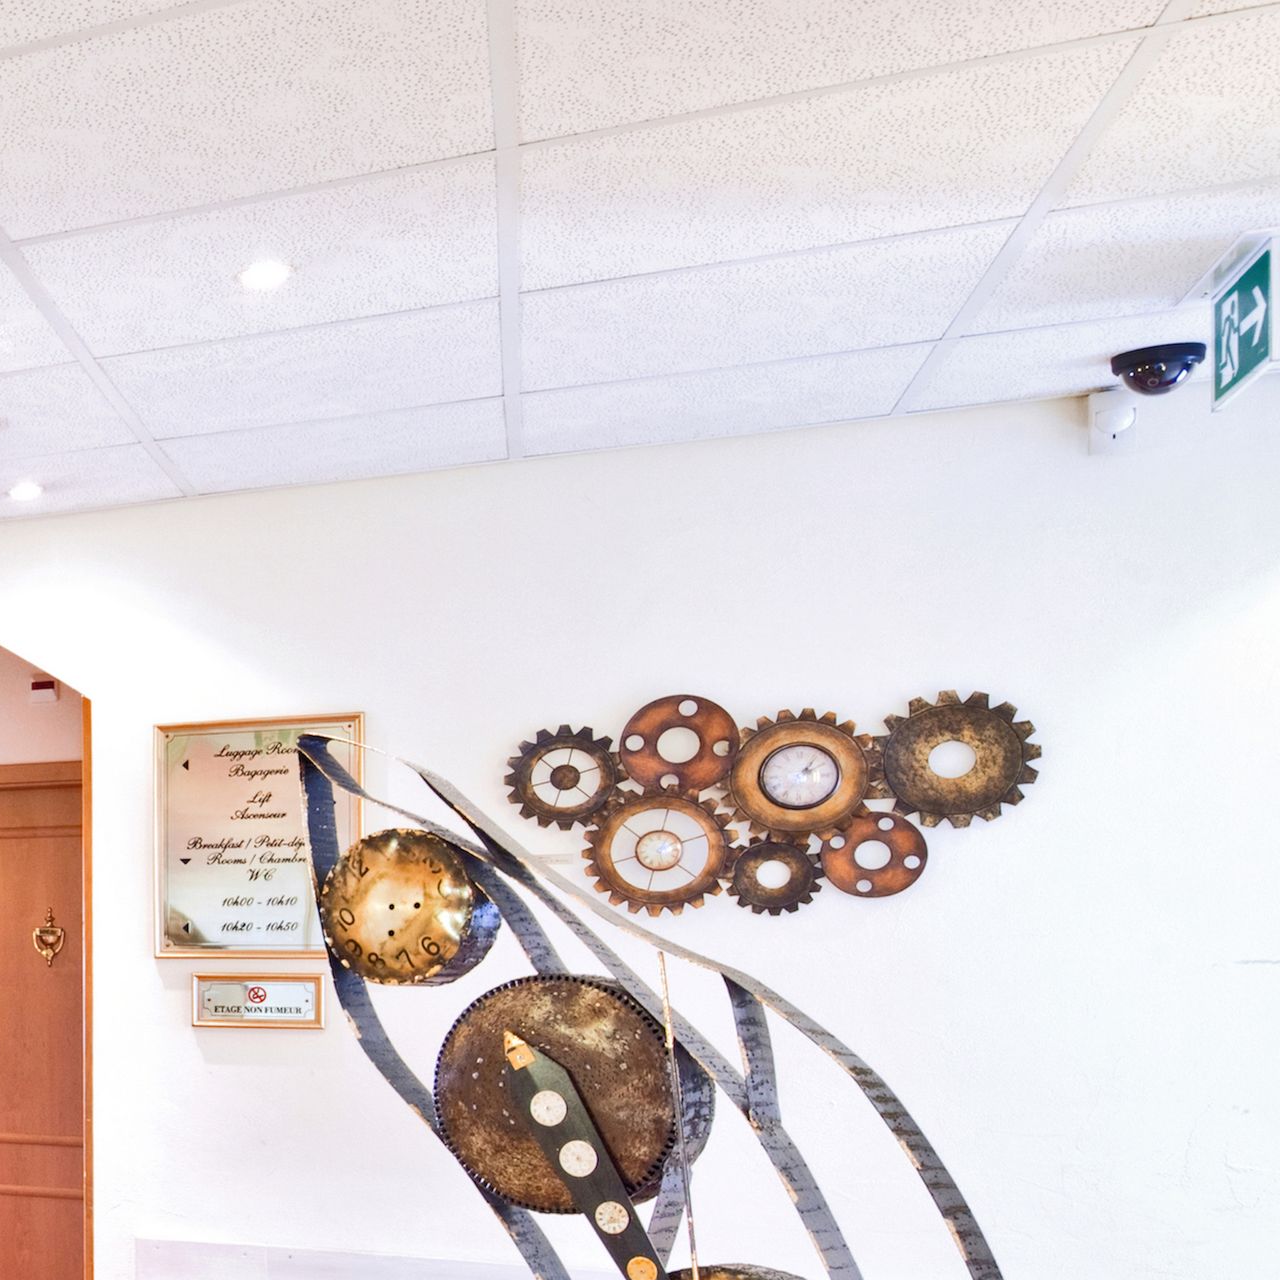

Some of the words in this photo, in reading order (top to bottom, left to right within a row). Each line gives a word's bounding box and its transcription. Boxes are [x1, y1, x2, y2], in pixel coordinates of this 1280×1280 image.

[213, 744, 263, 762] Luggage
[228, 764, 290, 781] Bagagerie
[246, 791, 272, 808] Lift
[230, 807, 287, 821] Ascenseur
[186, 836, 244, 854] Breakfast
[253, 834, 305, 852] Petit-déj
[206, 852, 247, 865] Rooms
[221, 895, 255, 908] 10h00
[266, 894, 298, 908] 10h10
[220, 920, 254, 933] 10h20
[265, 920, 299, 933] 10h50
[336, 907, 356, 932] 10
[421, 936, 441, 956] 6
[395, 948, 416, 969] 7
[213, 1005, 241, 1014] ETAGE
[244, 1006, 263, 1014] NON
[264, 1006, 302, 1015] FUMEUR
